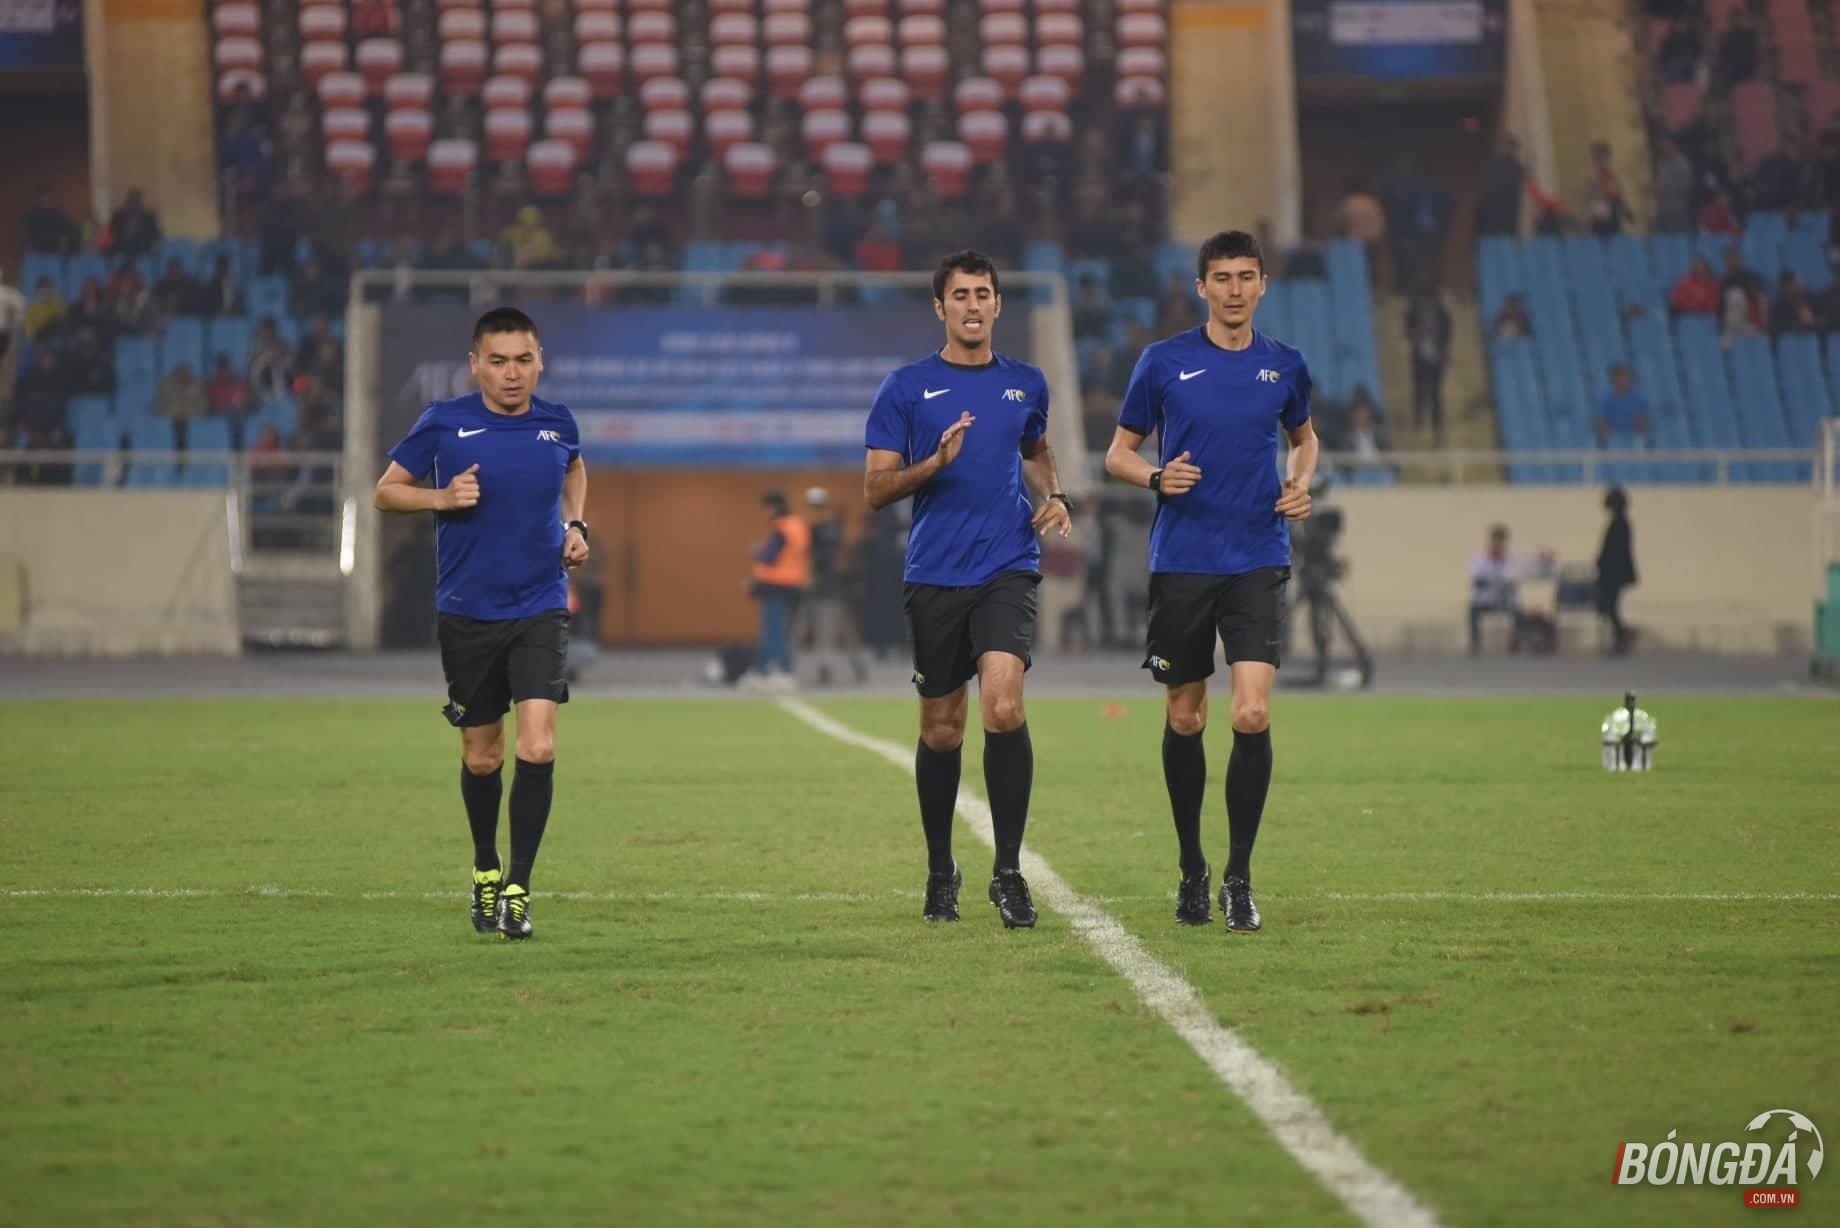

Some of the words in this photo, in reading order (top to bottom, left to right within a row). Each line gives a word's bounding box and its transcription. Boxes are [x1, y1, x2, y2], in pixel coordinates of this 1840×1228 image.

[1255, 368, 1281, 383] AFC
[1001, 388, 1025, 403] AFC
[536, 429, 561, 443] AFC
